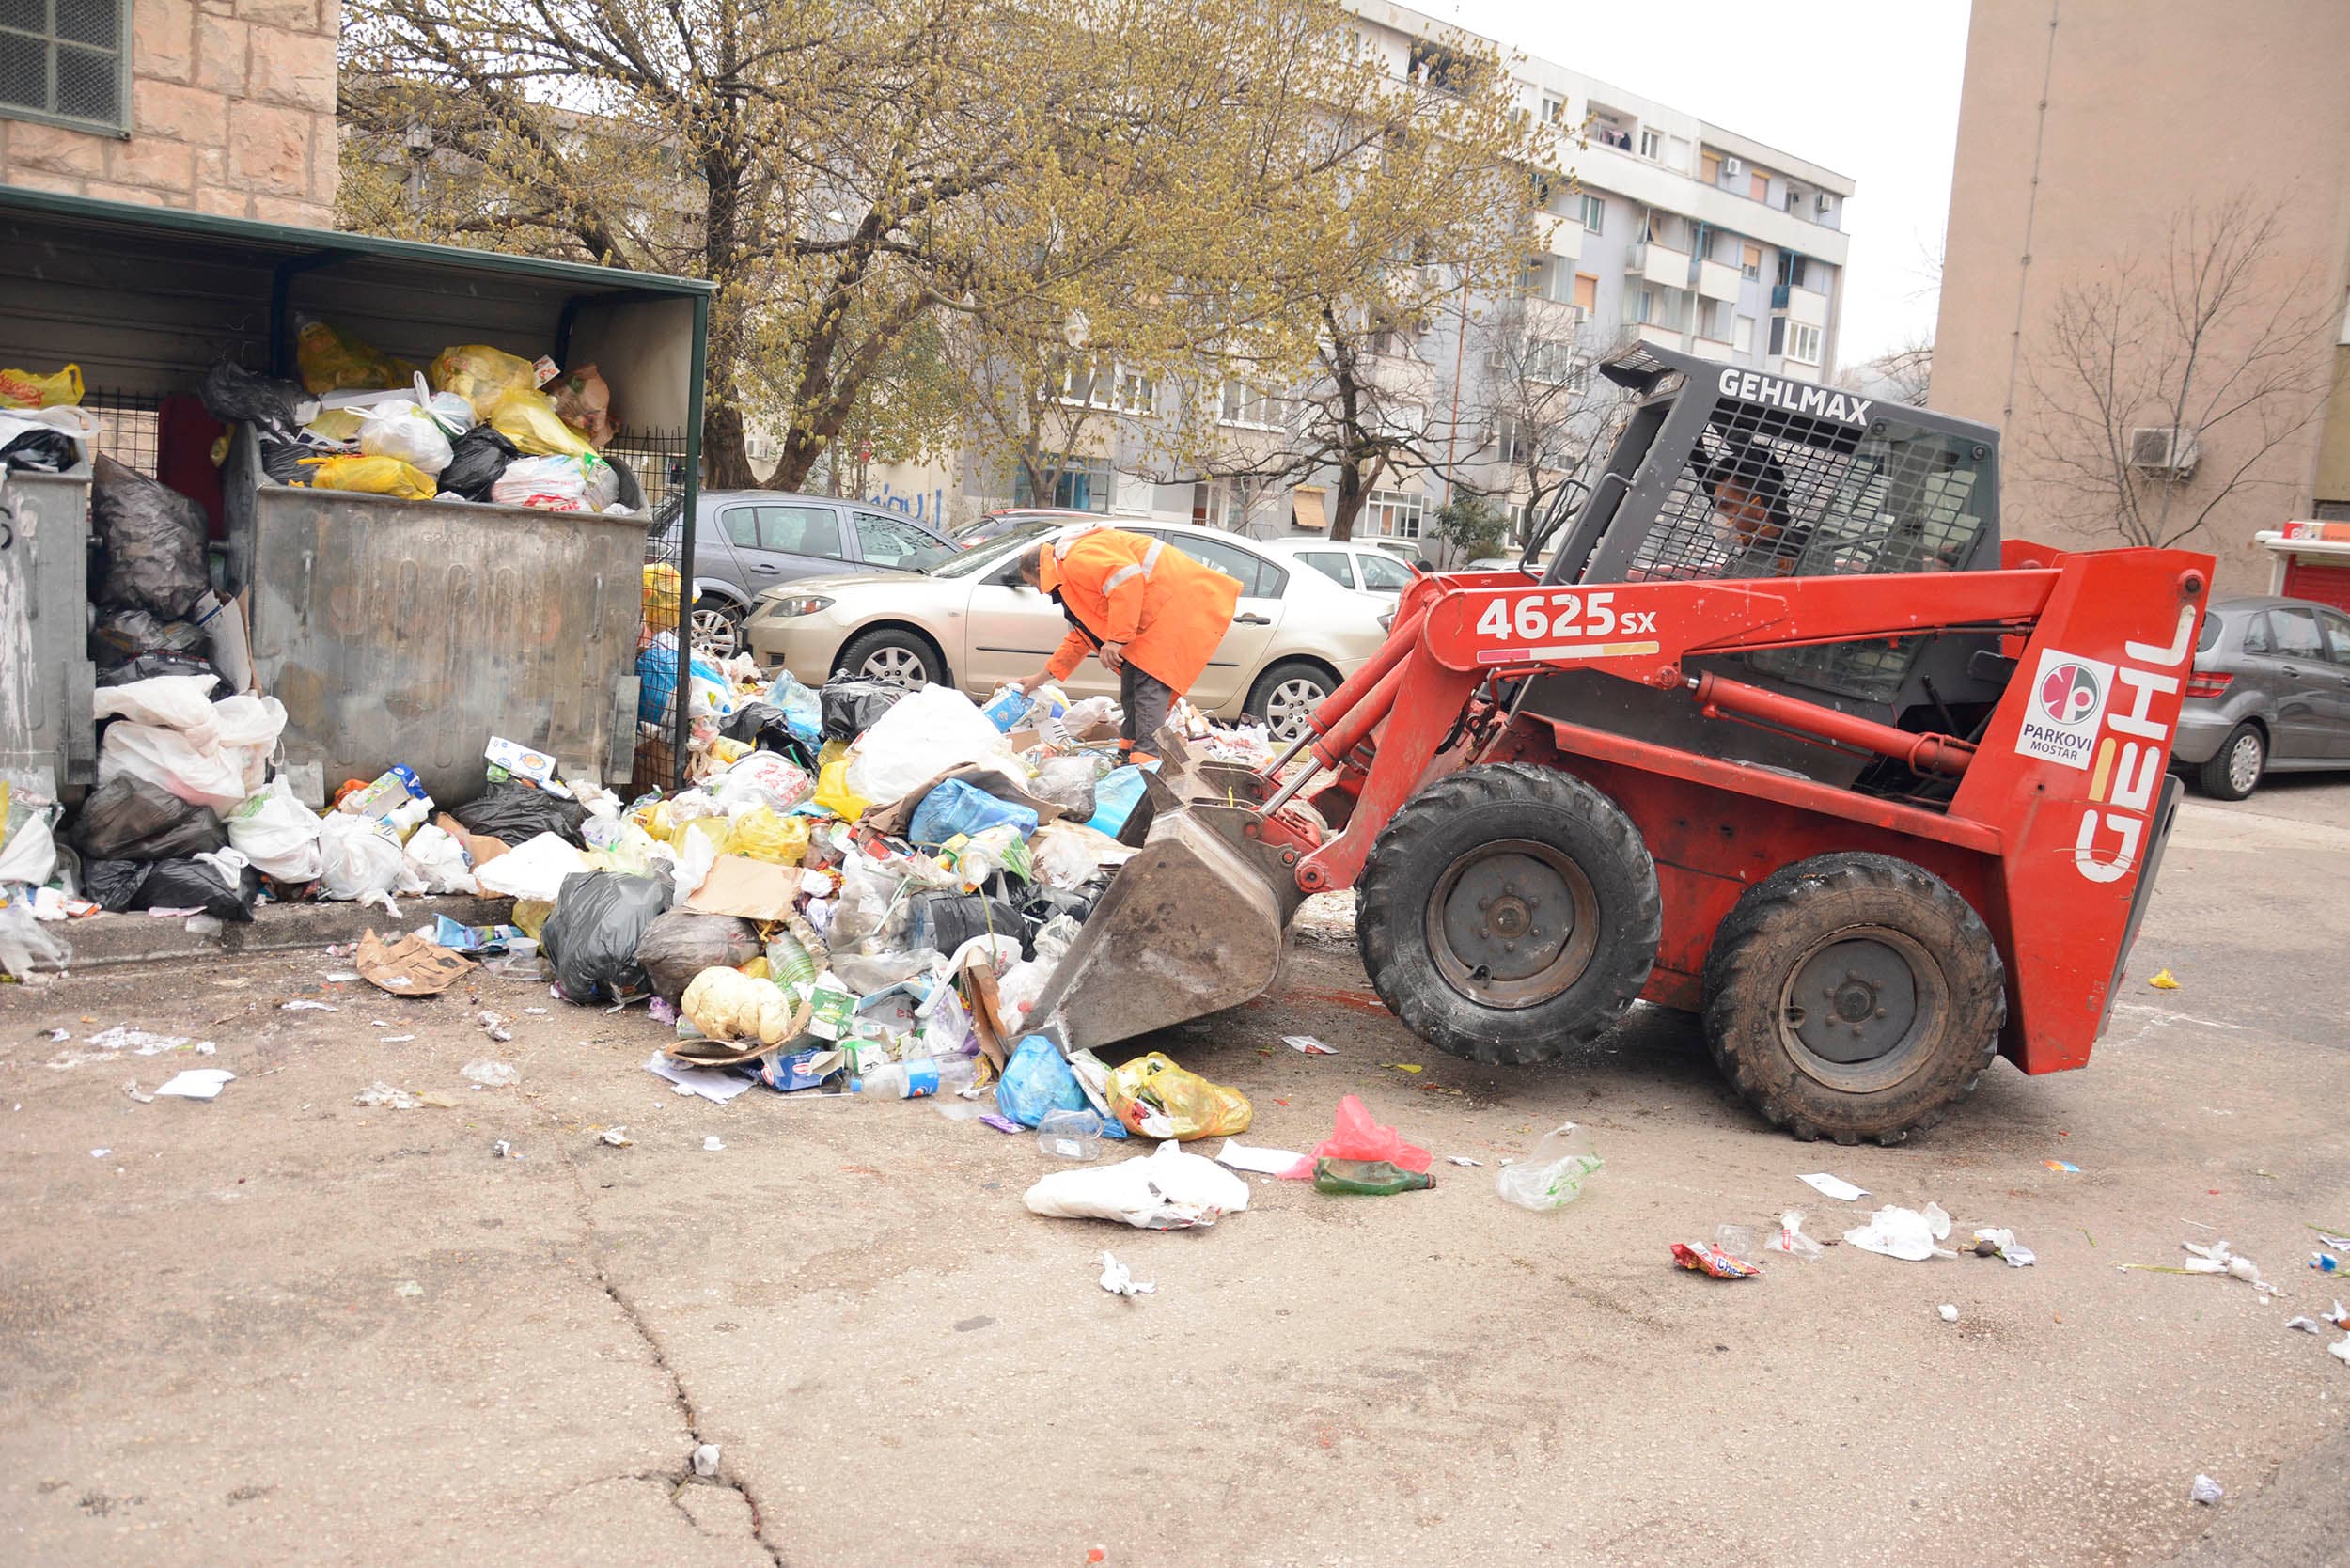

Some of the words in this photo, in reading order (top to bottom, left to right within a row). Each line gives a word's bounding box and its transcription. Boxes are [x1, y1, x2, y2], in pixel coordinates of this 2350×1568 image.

[1719, 368, 1872, 426] GEHLMAX
[1477, 593, 1616, 639] 4625
[1621, 611, 1656, 635] SX
[2023, 724, 2092, 751] PARKOVI
[2030, 741, 2078, 760] MOSTAR
[2075, 604, 2196, 883] GEHL
